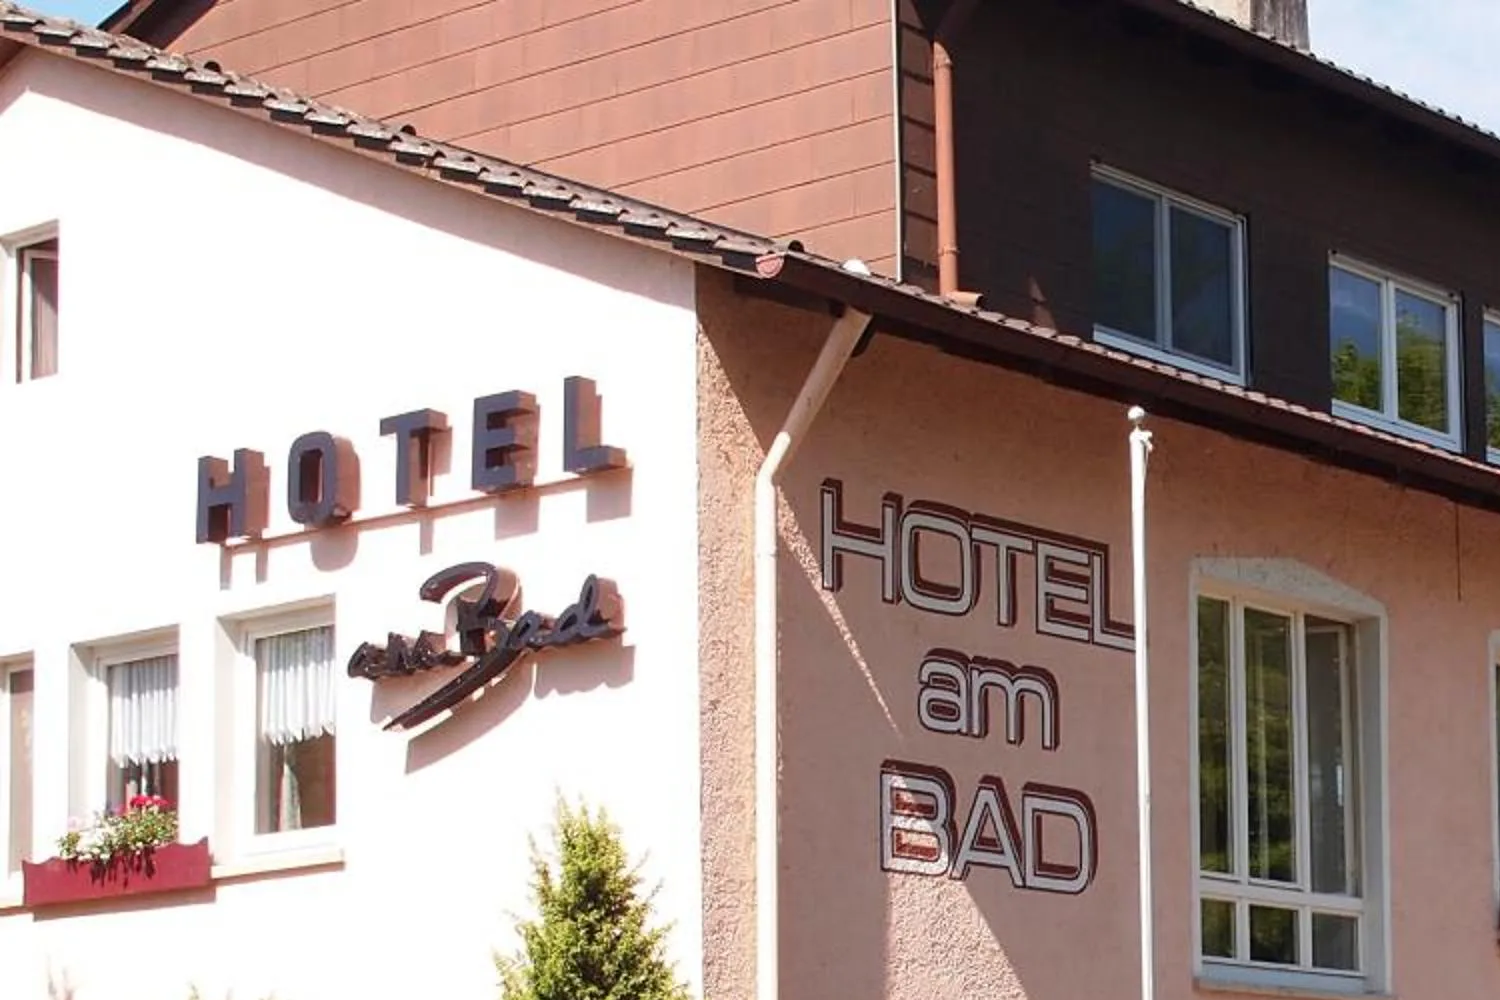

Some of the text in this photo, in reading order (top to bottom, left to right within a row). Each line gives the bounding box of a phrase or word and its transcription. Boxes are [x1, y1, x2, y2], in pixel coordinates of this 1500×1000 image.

[196, 376, 627, 545] HOTEL
[381, 560, 628, 732] Bad
[820, 478, 1136, 652] HOTEL
[917, 647, 1060, 751] am
[880, 759, 1098, 895] BAD
